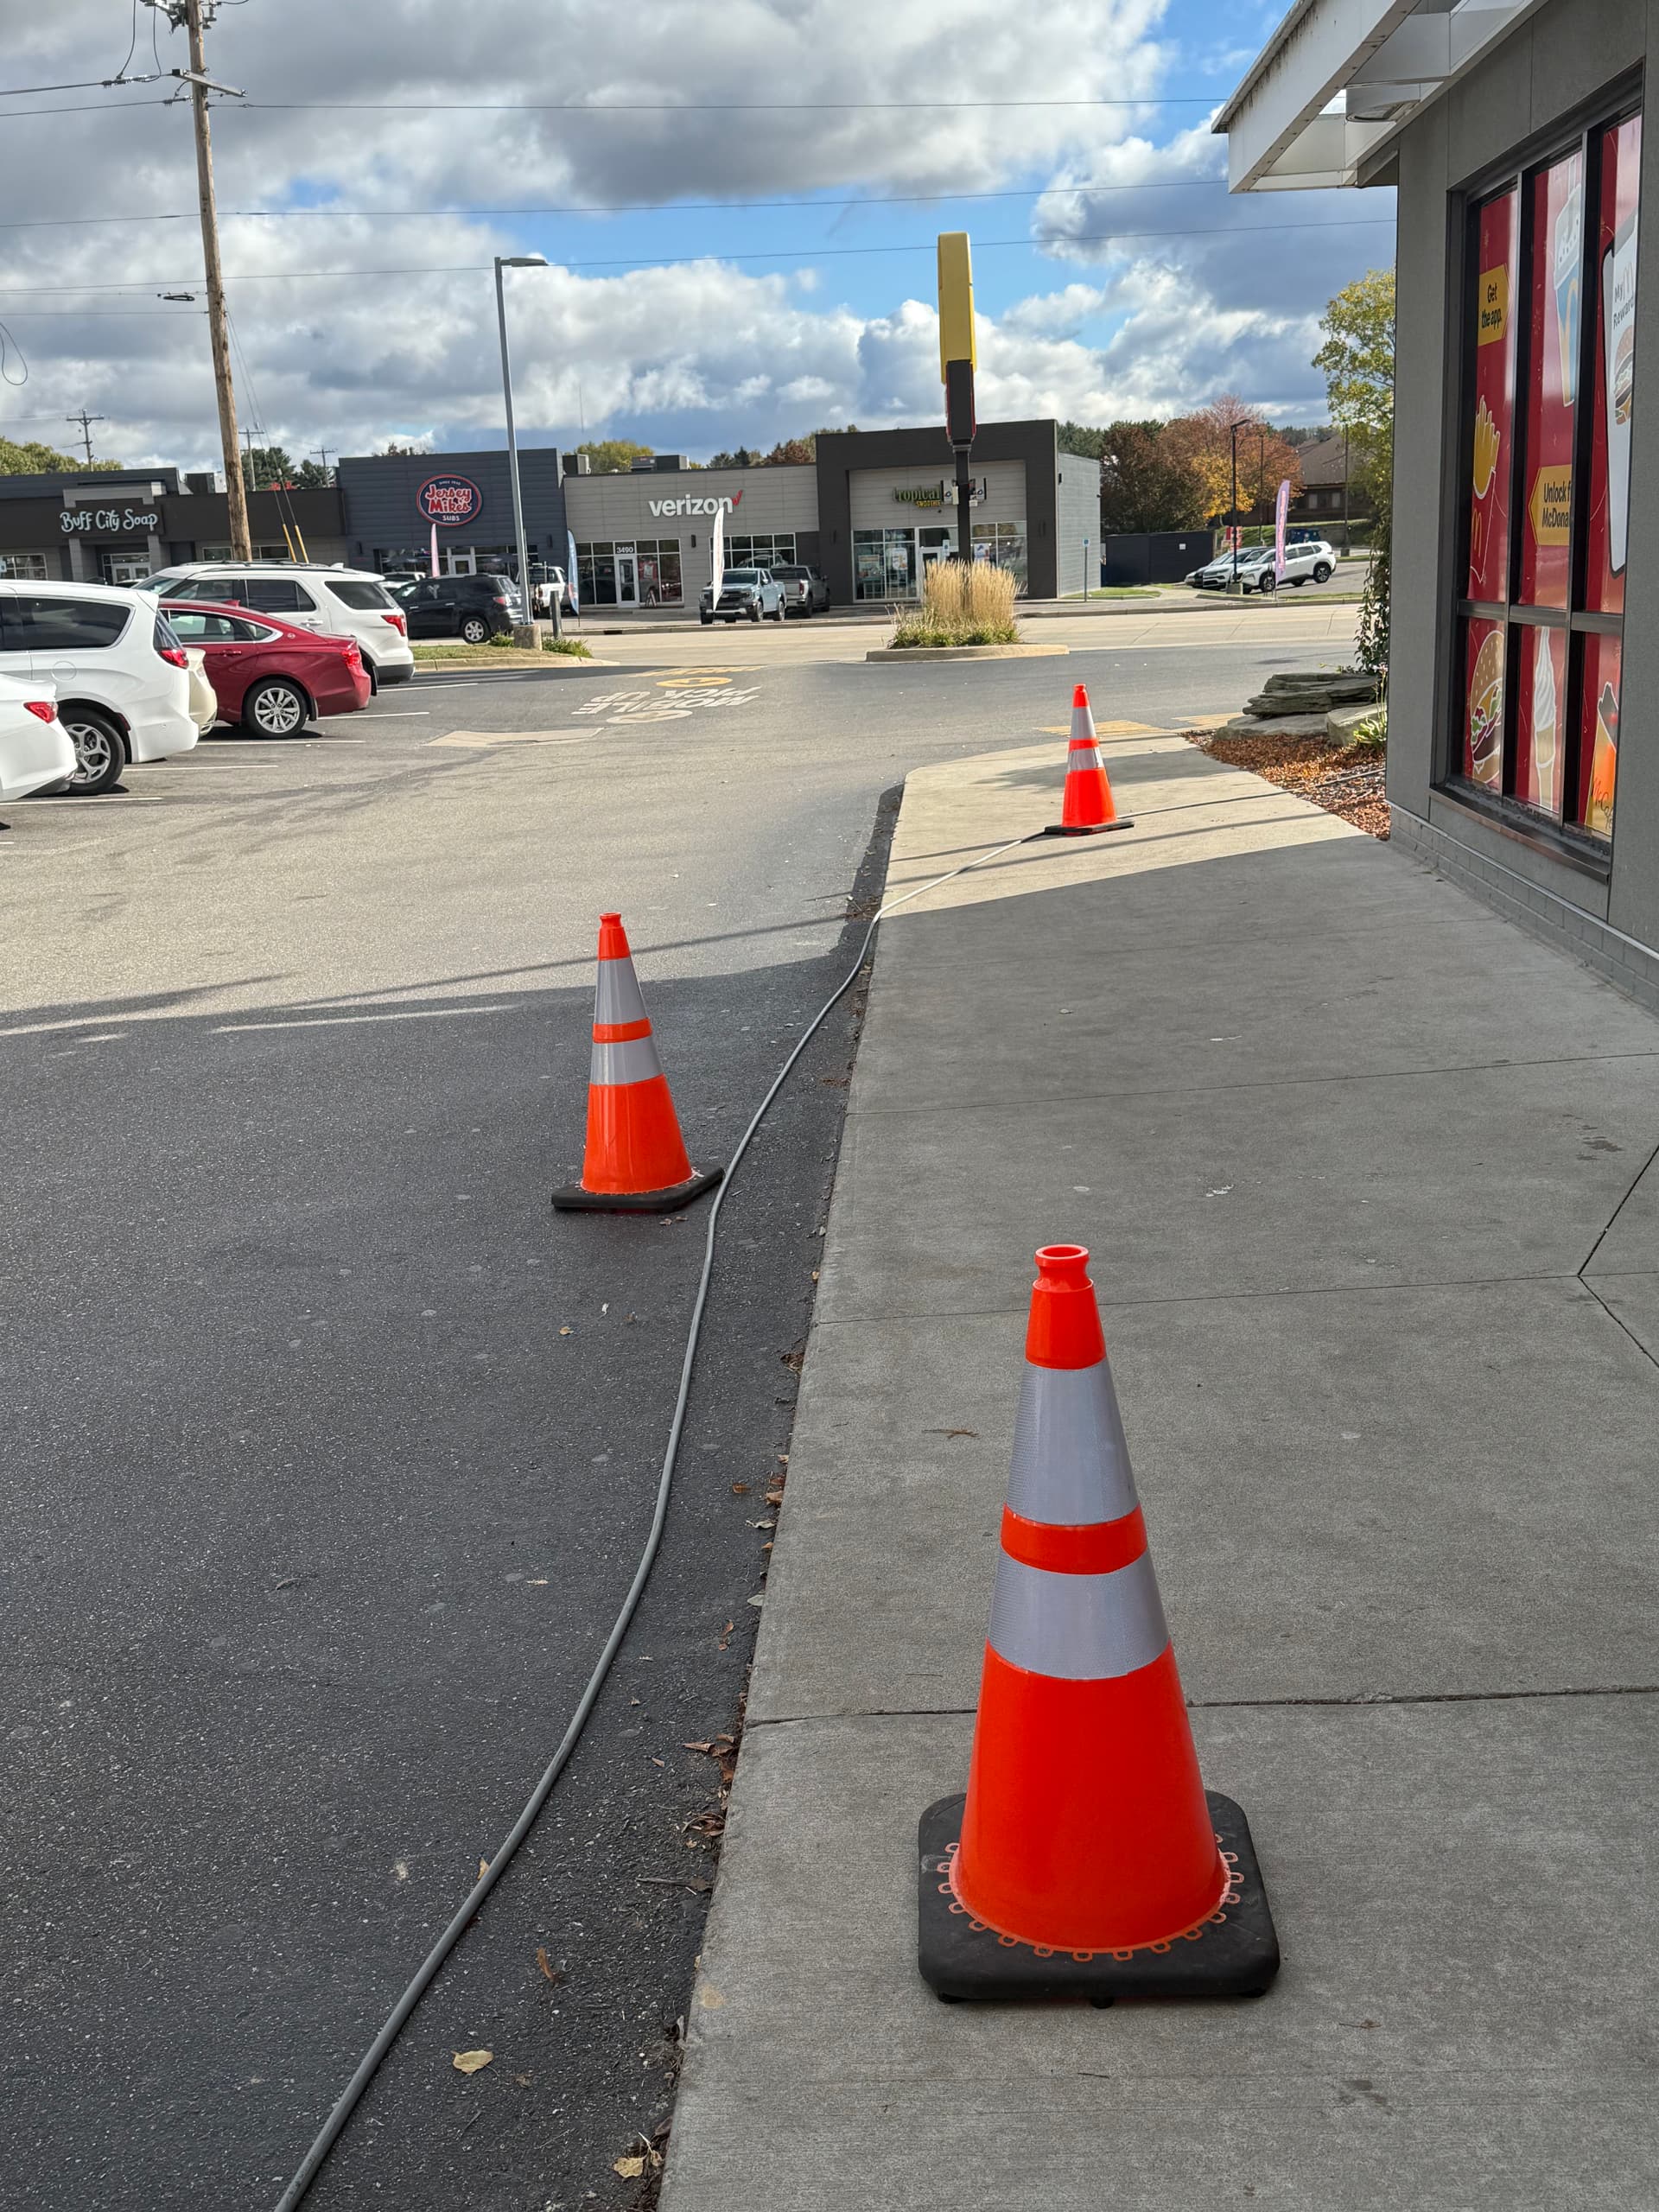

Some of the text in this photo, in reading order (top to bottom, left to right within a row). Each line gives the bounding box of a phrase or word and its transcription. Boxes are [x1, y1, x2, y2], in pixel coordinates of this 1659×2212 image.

[1487, 283, 1497, 303] Get
[1481, 308, 1491, 329] the
[425, 484, 472, 503] Jersey
[1543, 481, 1567, 503] Unlock
[649, 493, 733, 517] verizon
[60, 508, 158, 532] Buff City Soap
[571, 695, 760, 715] MOBILE
